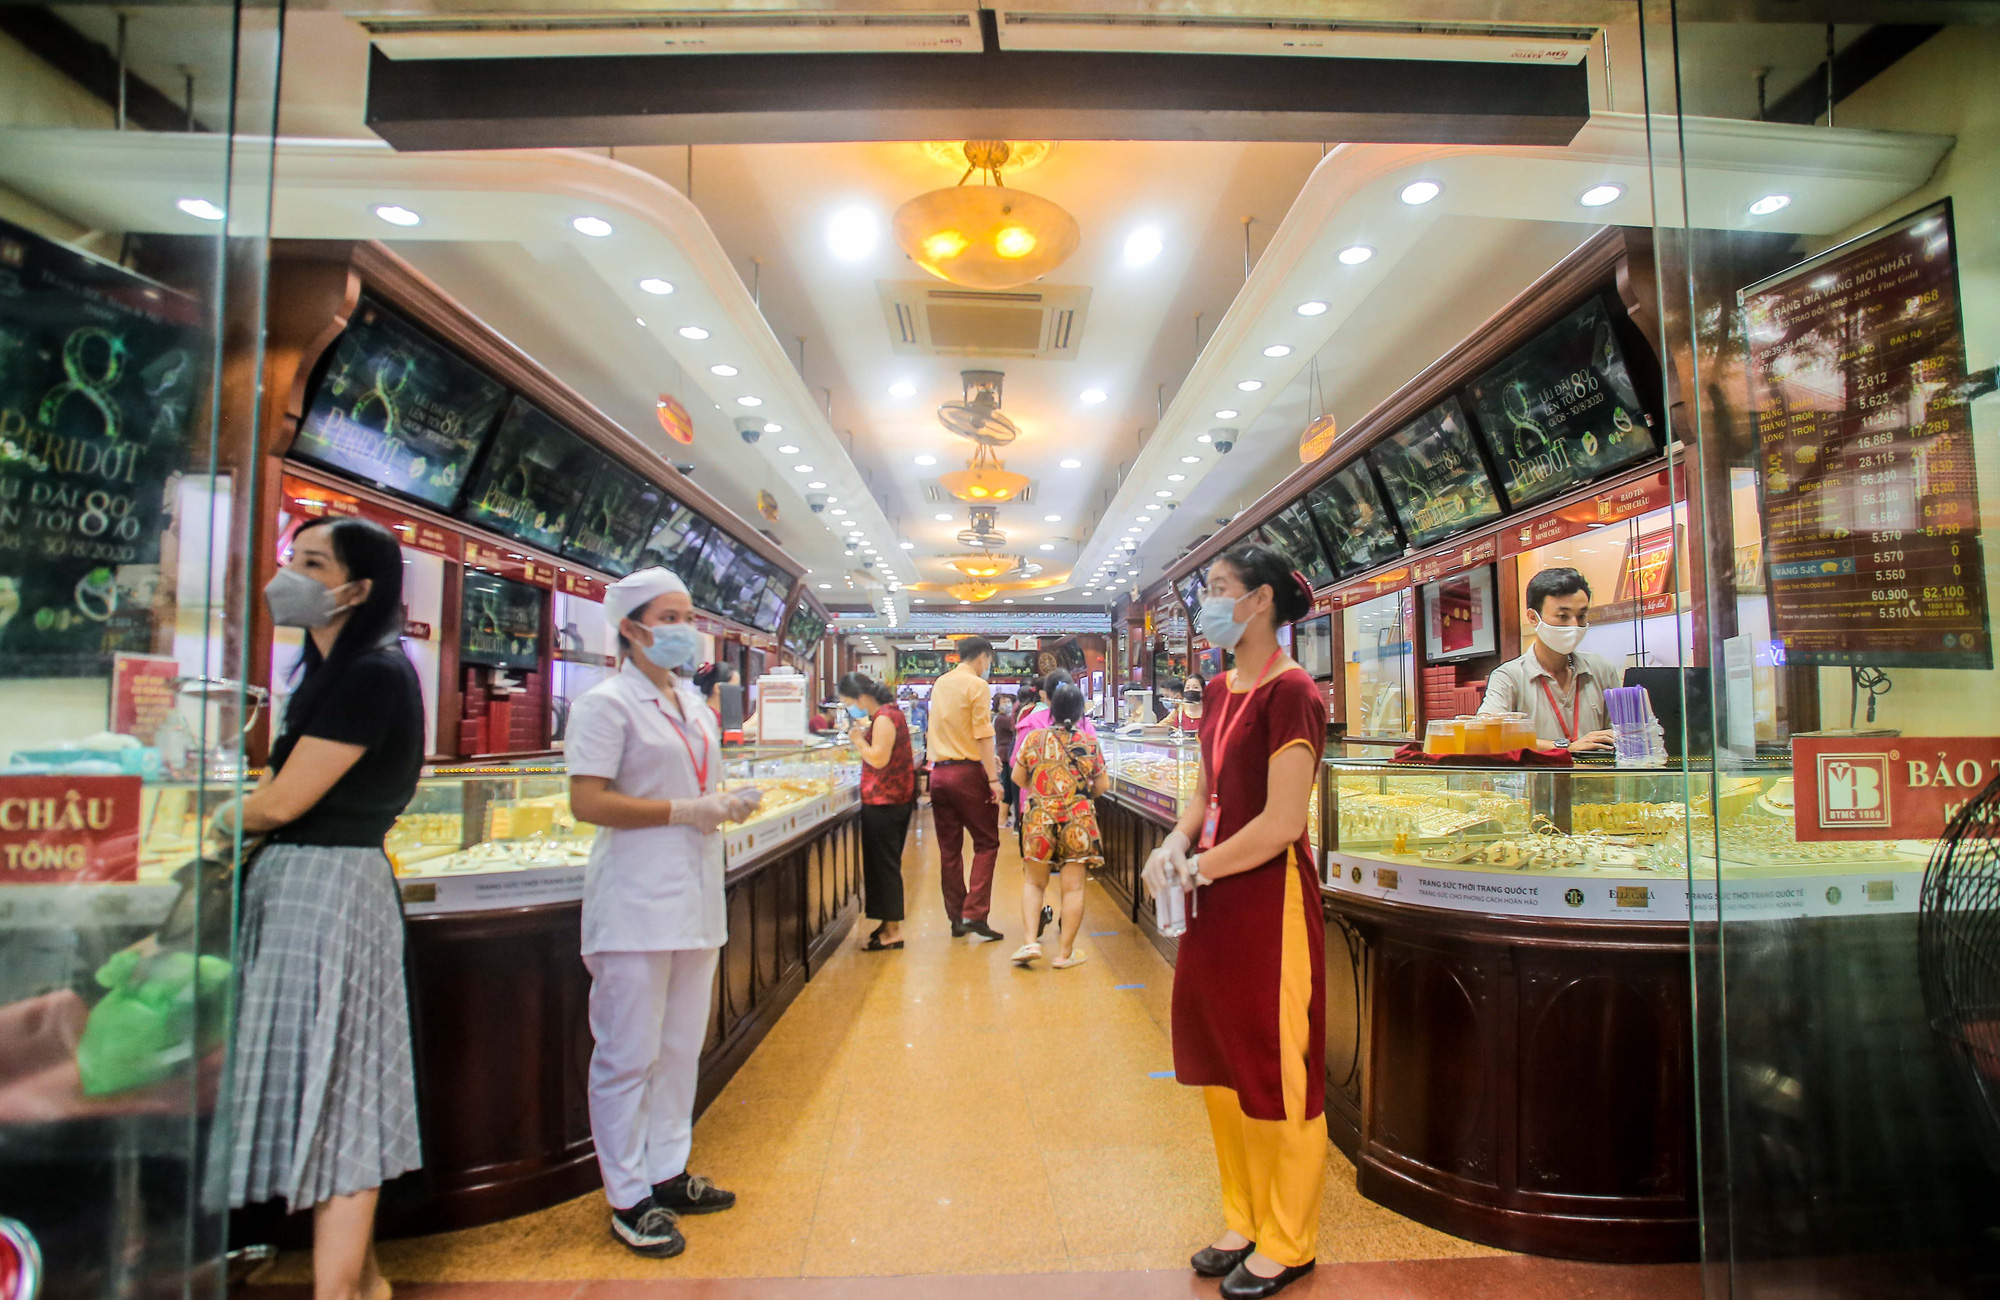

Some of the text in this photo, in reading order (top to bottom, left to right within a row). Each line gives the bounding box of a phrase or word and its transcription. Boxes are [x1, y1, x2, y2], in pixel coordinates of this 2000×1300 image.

[1773, 299, 1800, 319] BẢNG
[1855, 269, 1877, 286] MỚI
[1879, 253, 1914, 276] NHẤT
[1571, 368, 1599, 398] 8%
[1857, 371, 1888, 390] 2.812
[1859, 392, 1889, 410] 5.623
[1861, 410, 1897, 428] 11.246
[1909, 418, 1950, 438] 17.289
[1857, 430, 1894, 450] 16.869
[1508, 436, 1572, 490] PERIDOT
[1859, 450, 1895, 469] 28.115
[1861, 469, 1897, 487] 56.230
[1620, 490, 1634, 502] BẢO
[1863, 489, 1899, 506] 56.230
[78, 491, 140, 541] 8%
[1616, 502, 1632, 514] MINH
[1924, 502, 1959, 518] 5.720
[1869, 510, 1900, 525] 5.560
[1872, 529, 1902, 543] 5.570
[1926, 522, 1960, 538] 5.730
[1873, 550, 1904, 564] 5.570
[1951, 544, 1960, 557] 0
[1800, 565, 1817, 575] SJC
[1875, 568, 1906, 582] 5.560
[1953, 564, 1961, 576] 0
[1871, 588, 1909, 601] 60.900
[1923, 585, 1965, 599] 62.100
[1879, 606, 1909, 618] 5.510
[1906, 751, 1983, 788] BẢO
[0, 788, 114, 831] CHÂU
[1829, 810, 1881, 819] BTMC 1989
[1419, 878, 1539, 896] TRANG SỨC THỜI TRANG QUỐC TẾ
[1775, 888, 1795, 898] QUỐC
[1419, 889, 1437, 898] TRANG
[1437, 890, 1449, 899] SỨC
[1463, 894, 1485, 902] PHONG
[1485, 894, 1503, 904] CÁCH
[1504, 896, 1523, 906] HOÀN
[1524, 897, 1539, 906] HẢO
